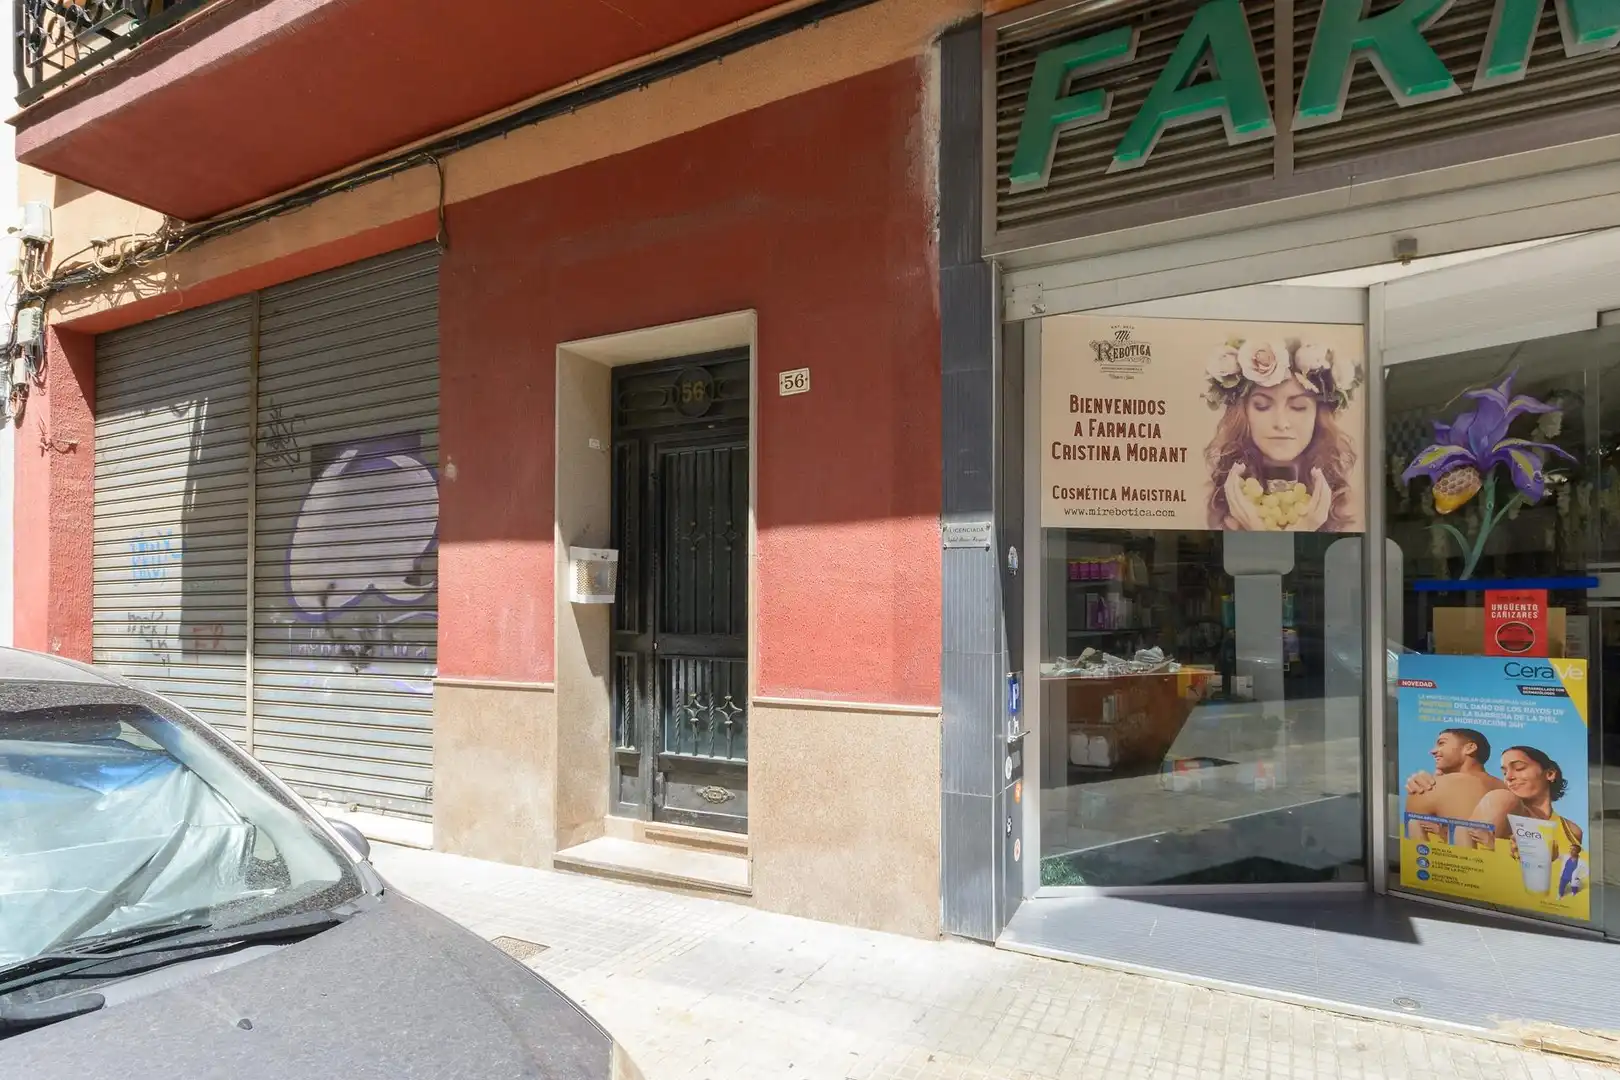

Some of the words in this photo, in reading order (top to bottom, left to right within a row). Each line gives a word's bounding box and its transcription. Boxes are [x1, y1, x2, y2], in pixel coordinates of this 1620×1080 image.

[784, 373, 804, 389] 56
[681, 380, 705, 402] 56
[1069, 394, 1166, 415] BIENVENIDOS
[1089, 418, 1161, 439] FARMACIA
[1051, 441, 1121, 461] CRISTINA
[1126, 443, 1187, 463] MORANT
[1052, 485, 1117, 501] COSMÉTICA
[1121, 486, 1187, 502] MAGISTRAL
[1064, 506, 1175, 517] www.mirebotica.com
[1491, 603, 1538, 611] UNGÜENTO
[1491, 611, 1538, 619] CAÑIZARES
[1504, 661, 1584, 680] CeraVe
[1402, 680, 1433, 688] NOVEDAD
